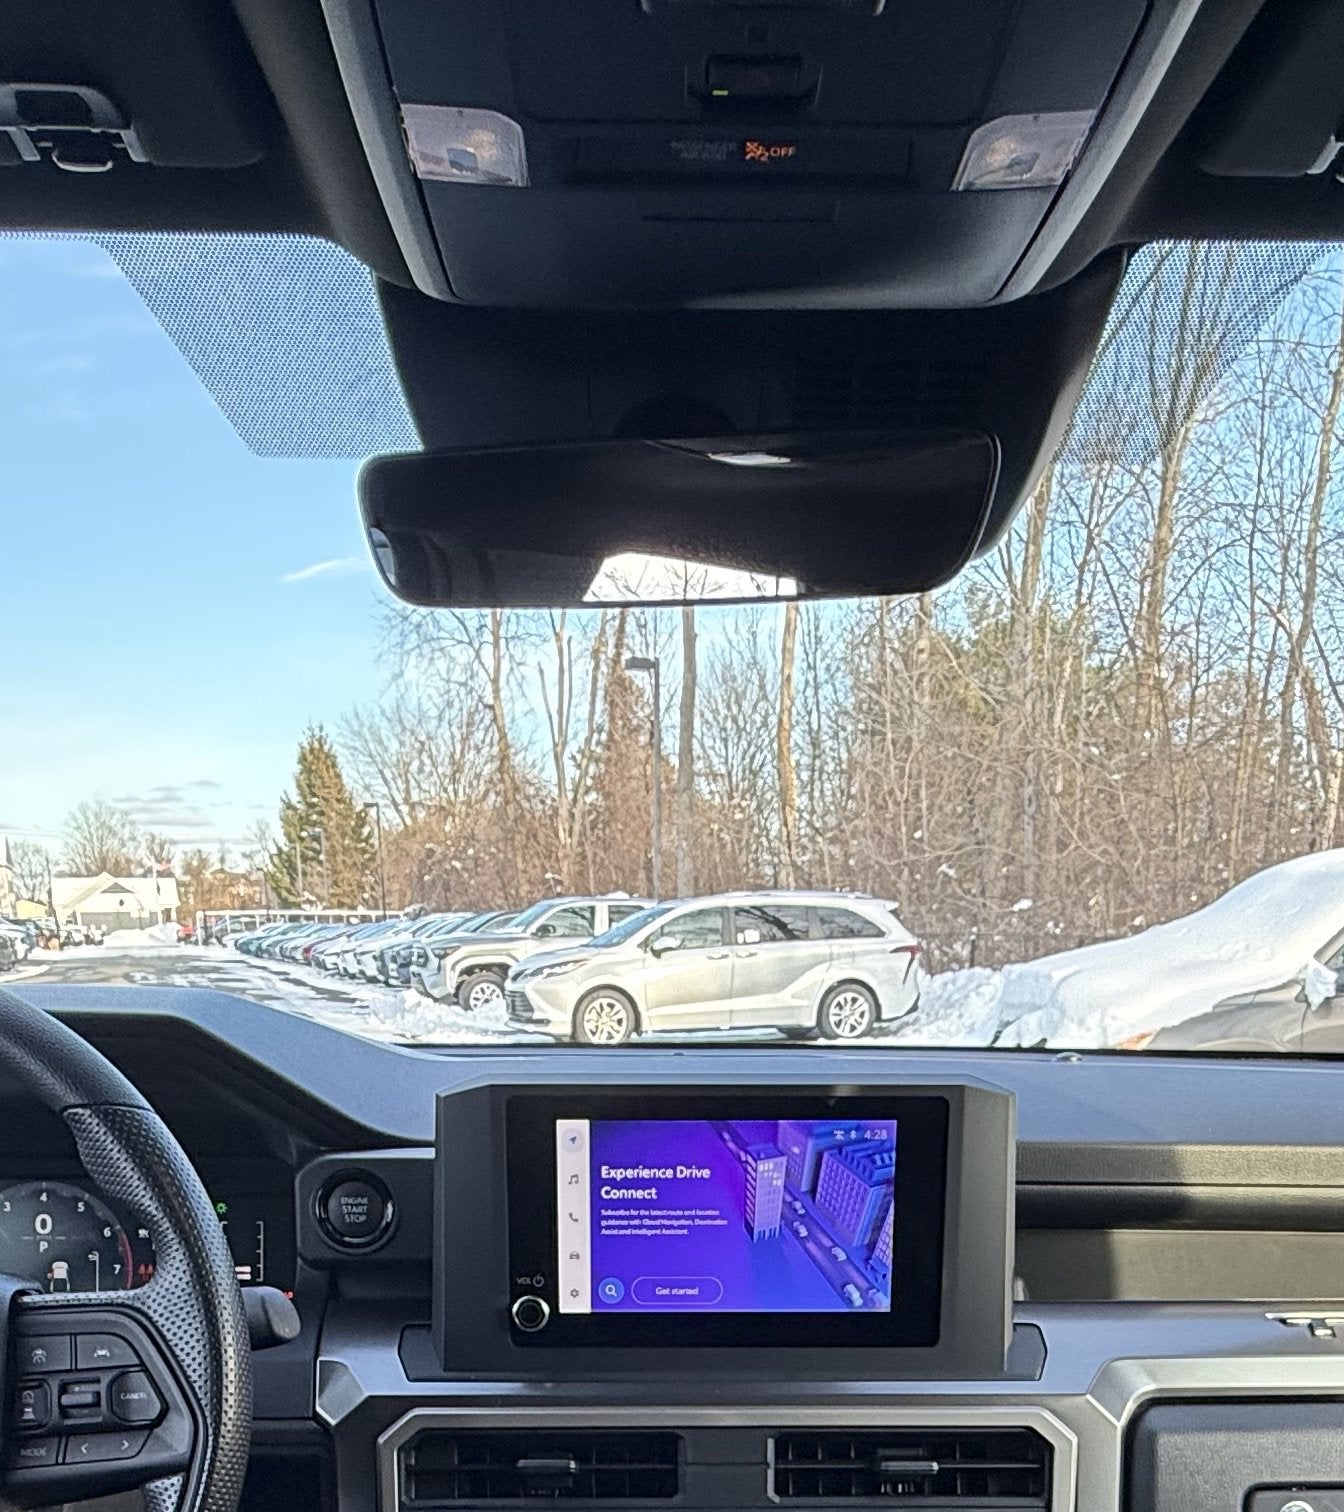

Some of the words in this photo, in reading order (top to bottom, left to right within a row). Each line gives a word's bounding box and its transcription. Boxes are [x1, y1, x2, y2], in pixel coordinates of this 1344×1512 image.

[770, 146, 796, 156] OFF
[863, 1129, 888, 1140] 4:28
[601, 1165, 674, 1181] Experience
[676, 1165, 711, 1179] Drive
[39, 1191, 48, 1202] 4
[600, 1186, 658, 1200] Connect
[341, 1197, 369, 1205] ENGINE
[3, 1202, 11, 1213] 3
[77, 1202, 85, 1213] 5
[342, 1205, 368, 1213] START
[35, 1213, 53, 1235] 0
[344, 1214, 367, 1223] STOP
[103, 1227, 111, 1238] 6
[39, 1241, 49, 1253] P
[112, 1264, 121, 1275] 7
[516, 1277, 531, 1285] VOL
[656, 1286, 669, 1296] Get
[672, 1286, 699, 1295] started
